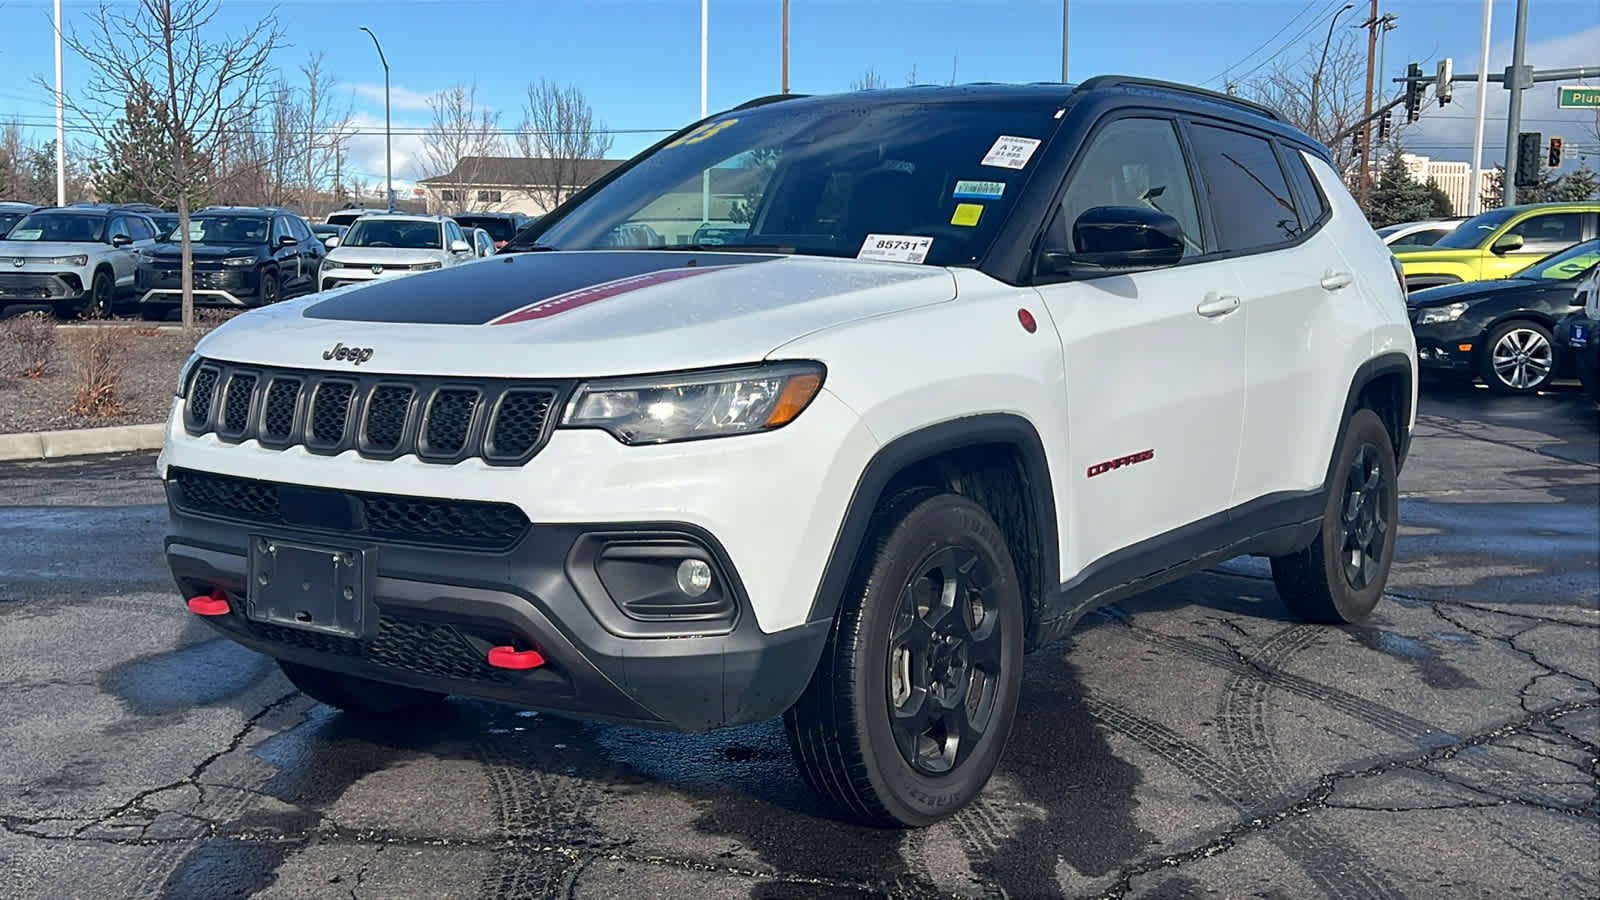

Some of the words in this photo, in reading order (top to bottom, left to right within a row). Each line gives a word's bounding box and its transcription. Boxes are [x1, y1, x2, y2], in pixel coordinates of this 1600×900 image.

[876, 240, 918, 250] 85731
[323, 342, 374, 366] Jeep
[1087, 448, 1155, 478] COMPASS
